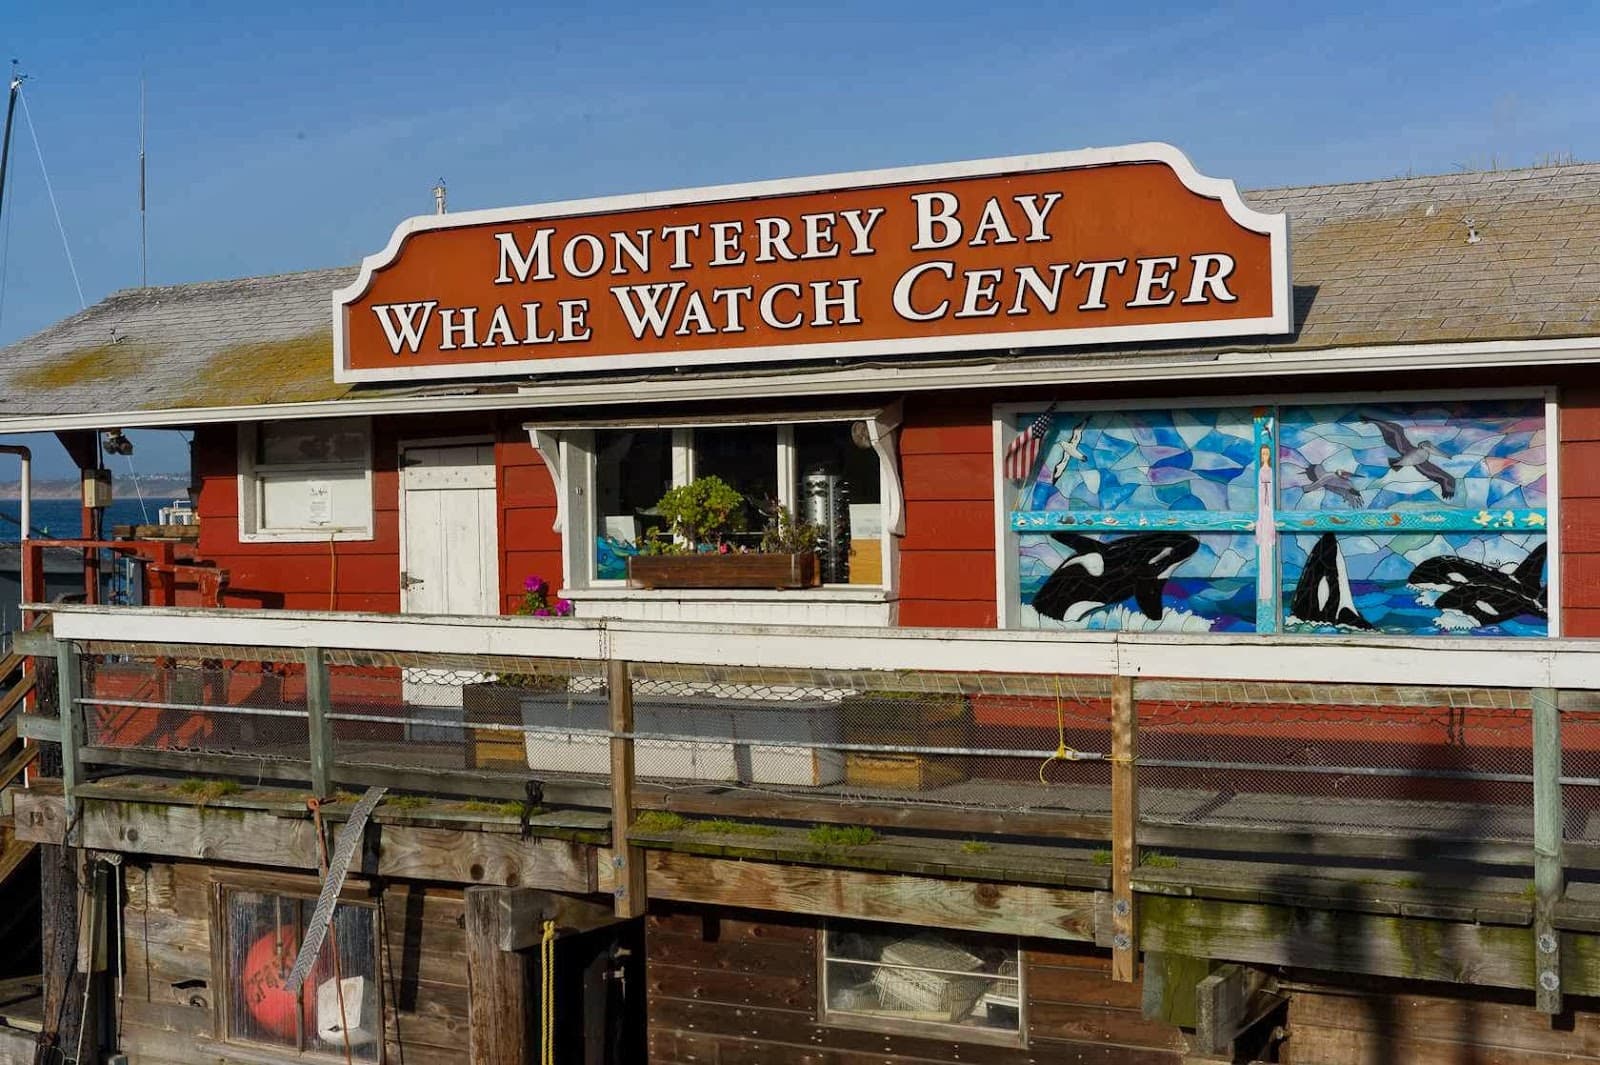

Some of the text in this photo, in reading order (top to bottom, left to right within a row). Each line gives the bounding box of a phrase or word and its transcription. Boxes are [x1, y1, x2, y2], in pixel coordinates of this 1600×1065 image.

[494, 191, 1063, 284] MONTEREY BAY
[371, 254, 1237, 355] WHALE WATCH CENTER
